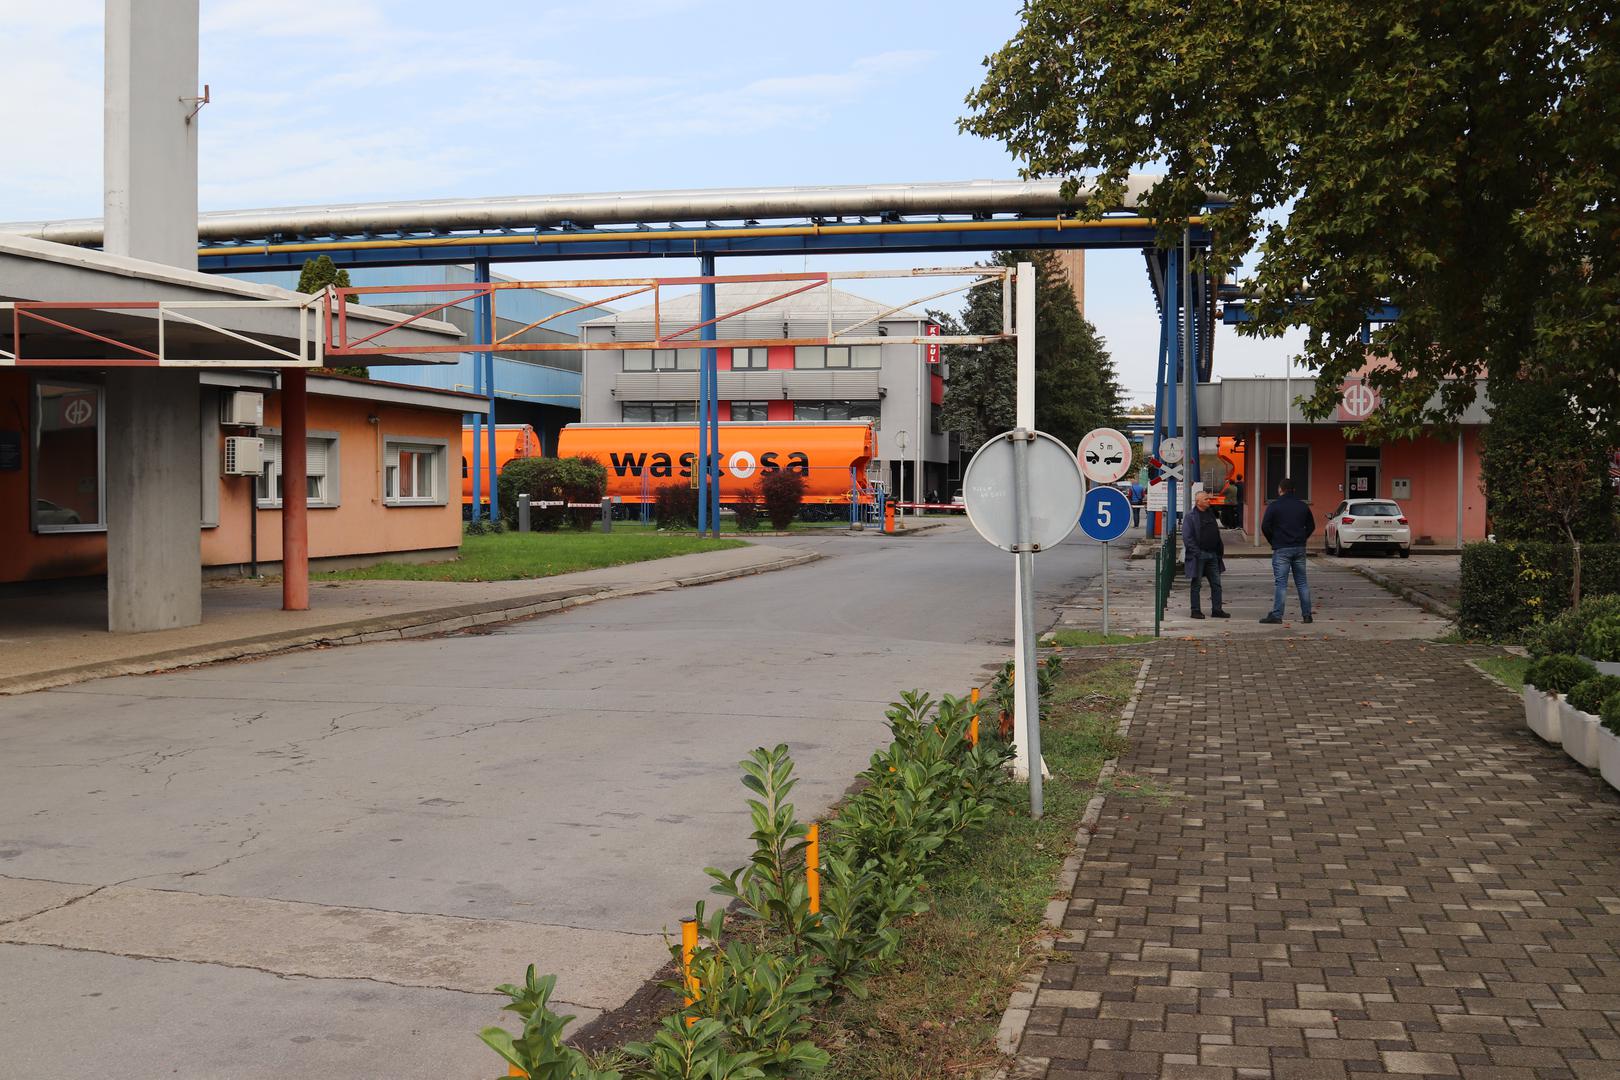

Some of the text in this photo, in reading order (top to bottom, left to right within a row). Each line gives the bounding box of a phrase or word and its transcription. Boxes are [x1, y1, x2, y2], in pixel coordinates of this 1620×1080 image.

[1099, 442, 1105, 450] 5
[610, 450, 809, 479] wascosa
[1097, 501, 1112, 528] 5
